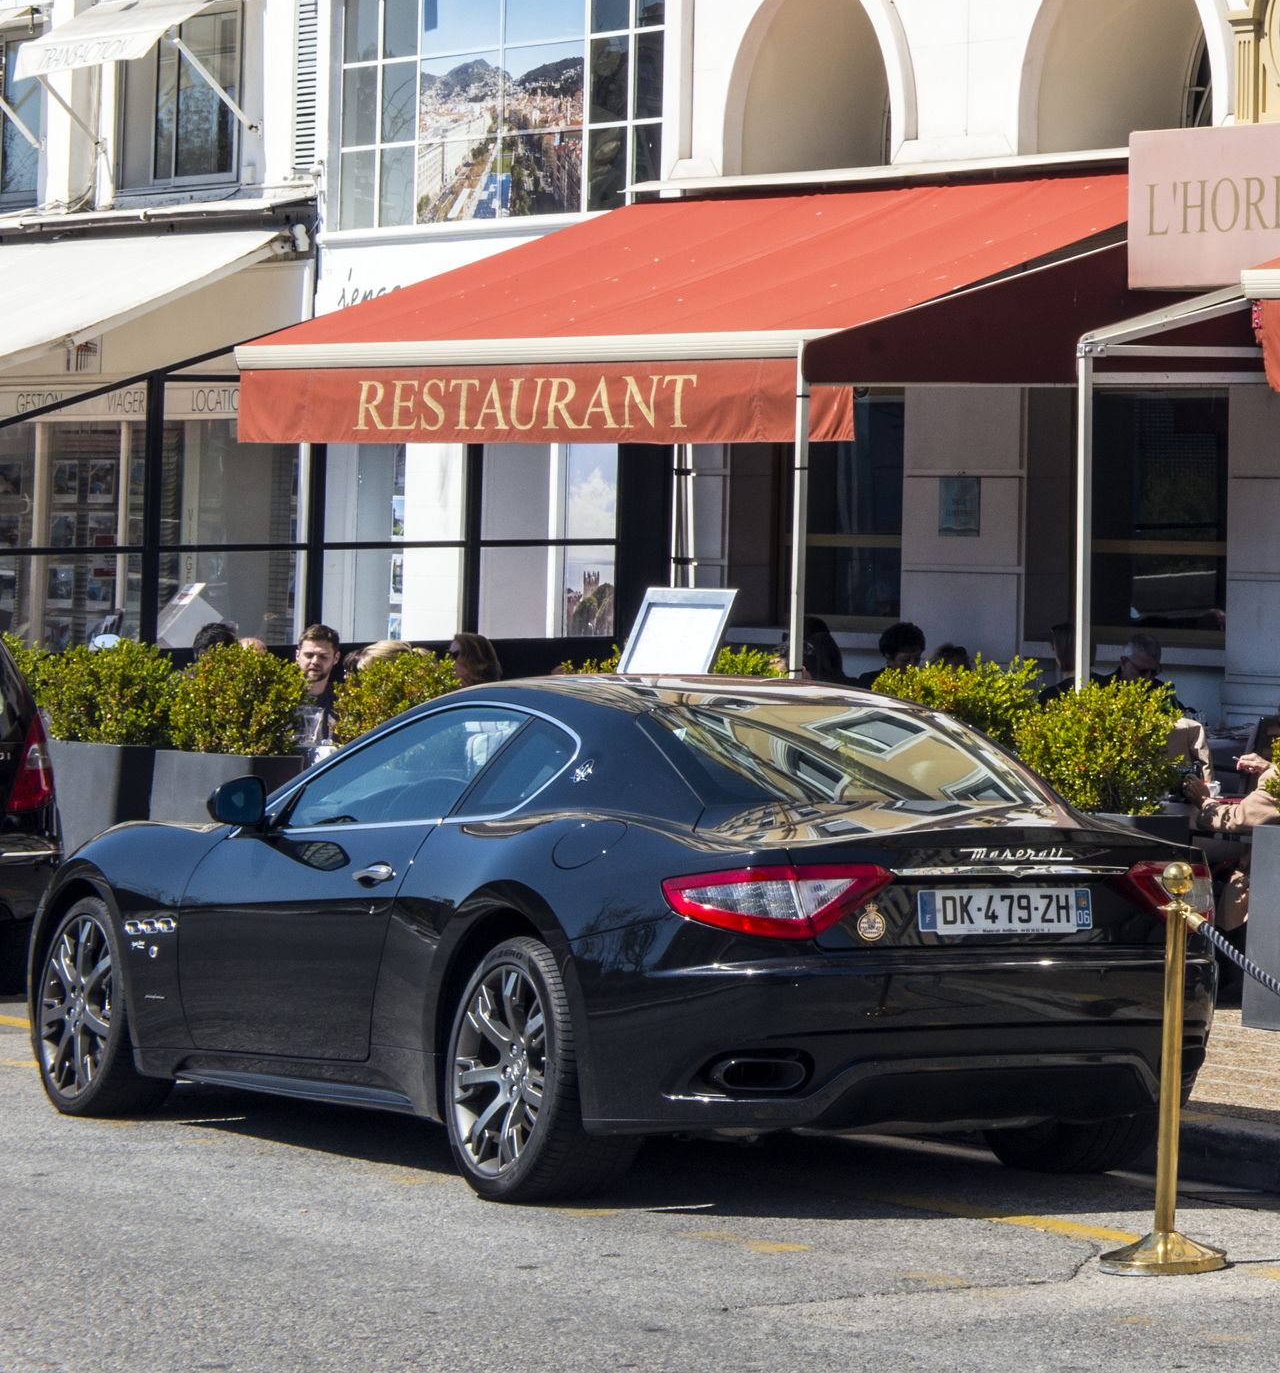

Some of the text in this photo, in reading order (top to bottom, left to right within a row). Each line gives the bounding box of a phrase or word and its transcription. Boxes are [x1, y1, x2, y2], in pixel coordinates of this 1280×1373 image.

[36, 35, 135, 70] TRANSACTION
[107, 390, 145, 414] VIAGER
[191, 388, 240, 413] LOCATIO
[352, 374, 698, 431] RESTAURANT
[960, 847, 1074, 863] Maserati
[925, 894, 1091, 926] F DK-479-ZH 06
